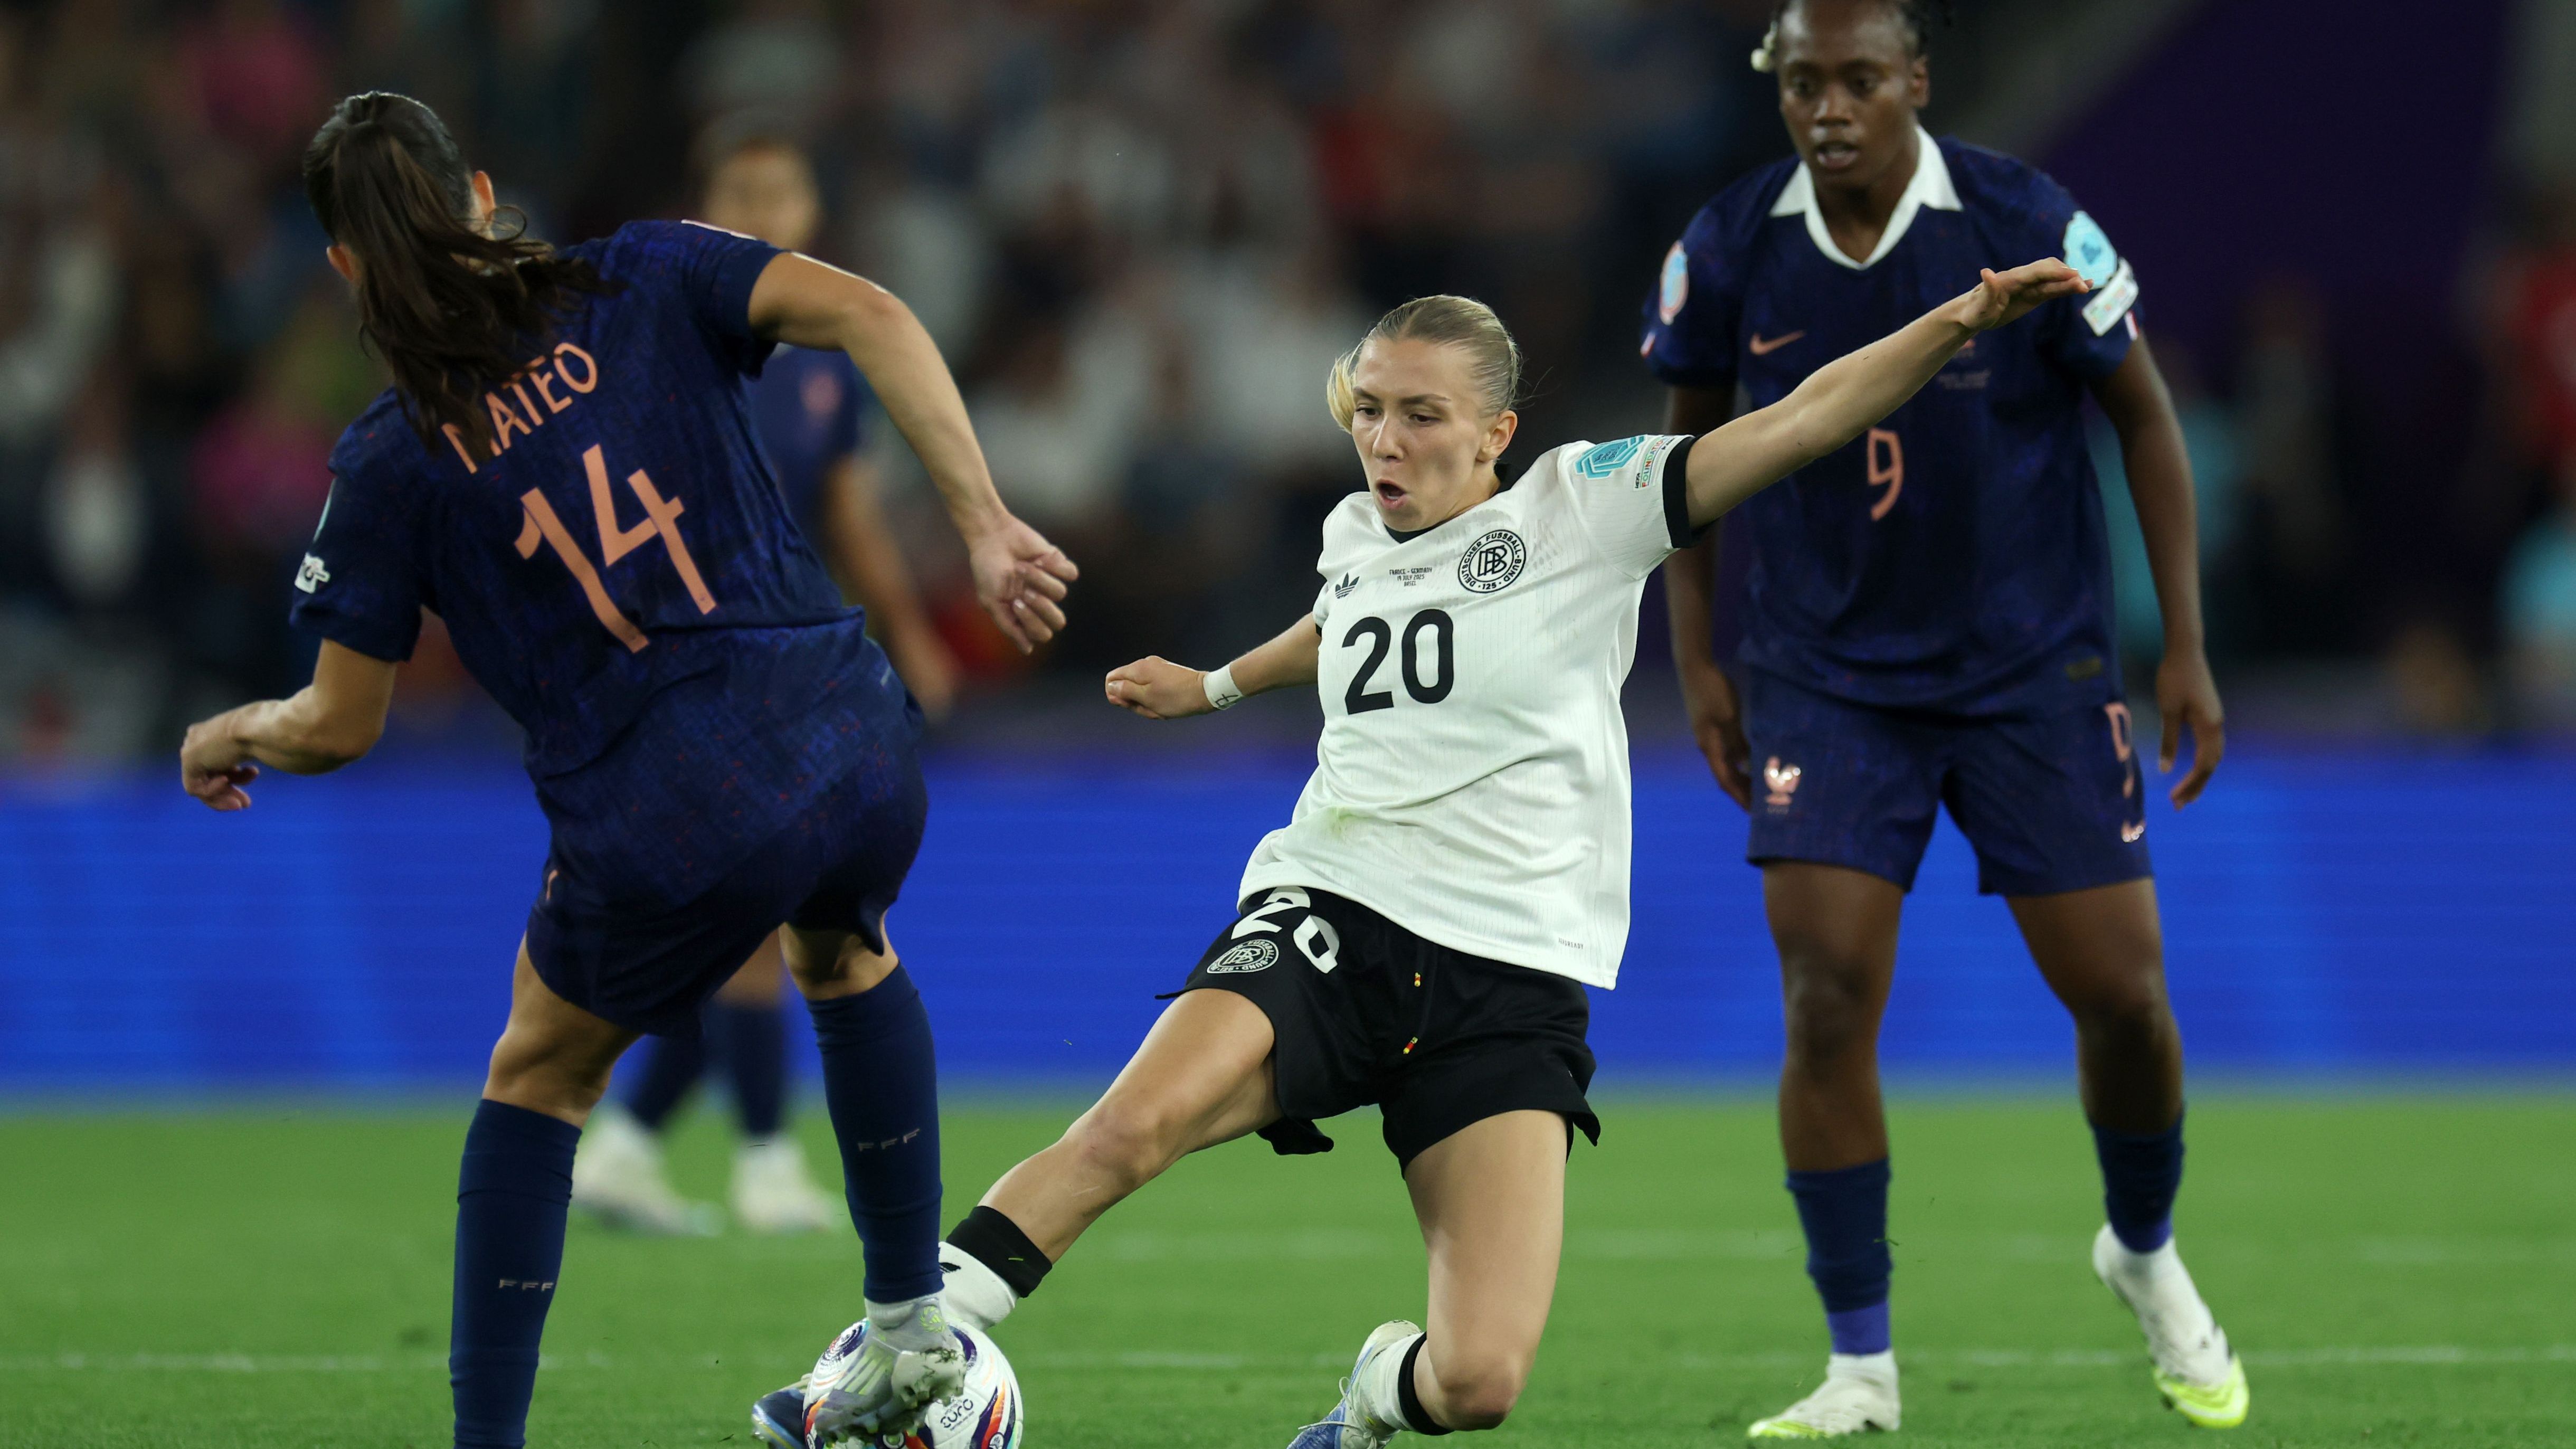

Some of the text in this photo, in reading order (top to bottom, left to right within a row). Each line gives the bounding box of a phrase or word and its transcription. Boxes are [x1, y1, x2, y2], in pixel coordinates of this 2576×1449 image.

[1867, 428, 1902, 521] 9
[514, 443, 717, 654] 14
[1461, 541, 1483, 587] DEUTSCHER
[1341, 609, 1454, 715] 20
[1230, 885, 1340, 974] 20
[499, 1279, 553, 1291] FFF
